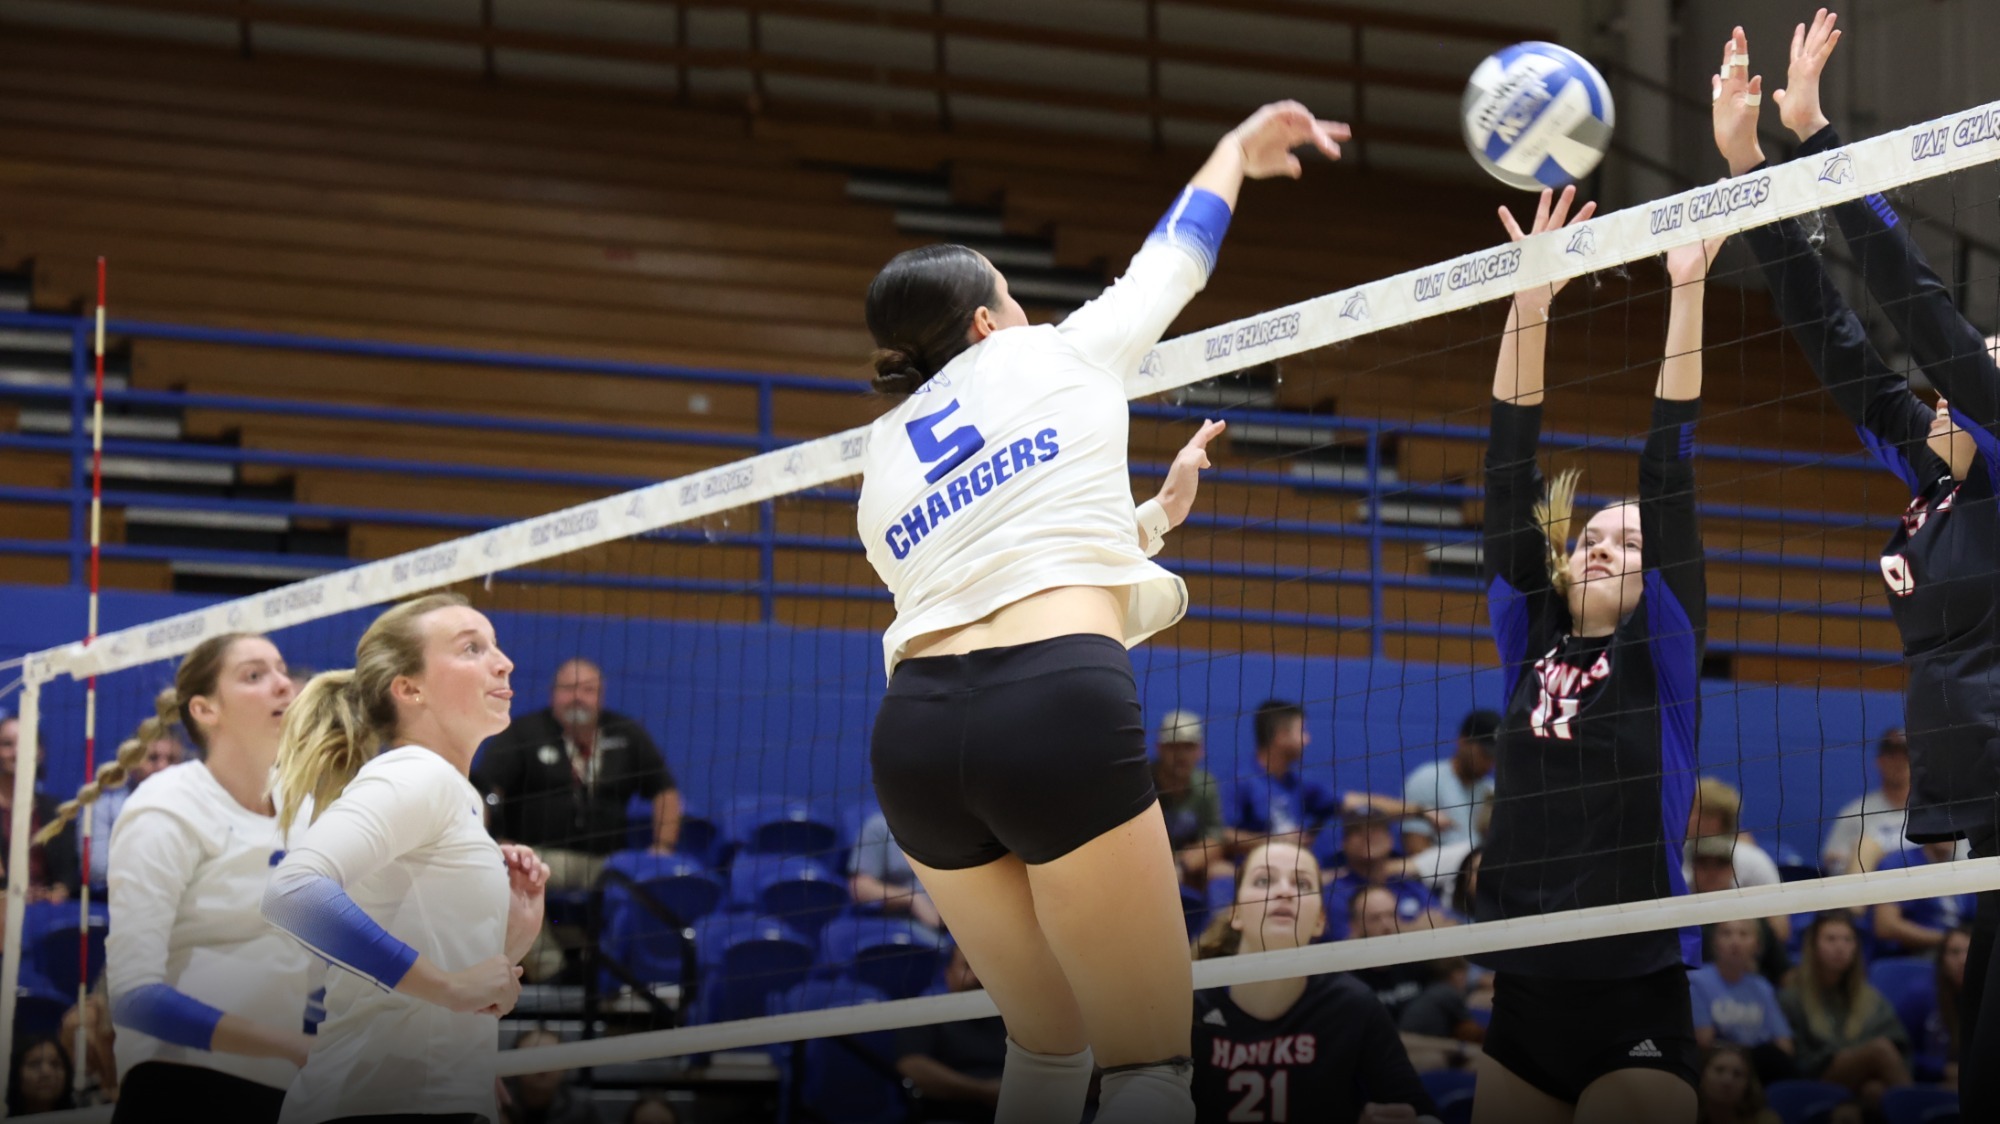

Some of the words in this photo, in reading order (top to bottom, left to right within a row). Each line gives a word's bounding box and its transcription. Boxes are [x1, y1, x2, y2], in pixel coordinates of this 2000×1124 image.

[1911, 127, 1950, 161] UAH
[1651, 203, 1683, 235] UAH
[1688, 176, 1771, 222] CHARGERS
[1414, 272, 1446, 302] UAH
[1447, 248, 1521, 290] CHARGERS
[1205, 333, 1234, 361] UAH
[1235, 312, 1301, 351] CHARGERS
[905, 398, 985, 485] 5
[885, 427, 1060, 560] CHARGERS
[1211, 1033, 1316, 1071] HAWKS
[1228, 1070, 1288, 1123] 21
